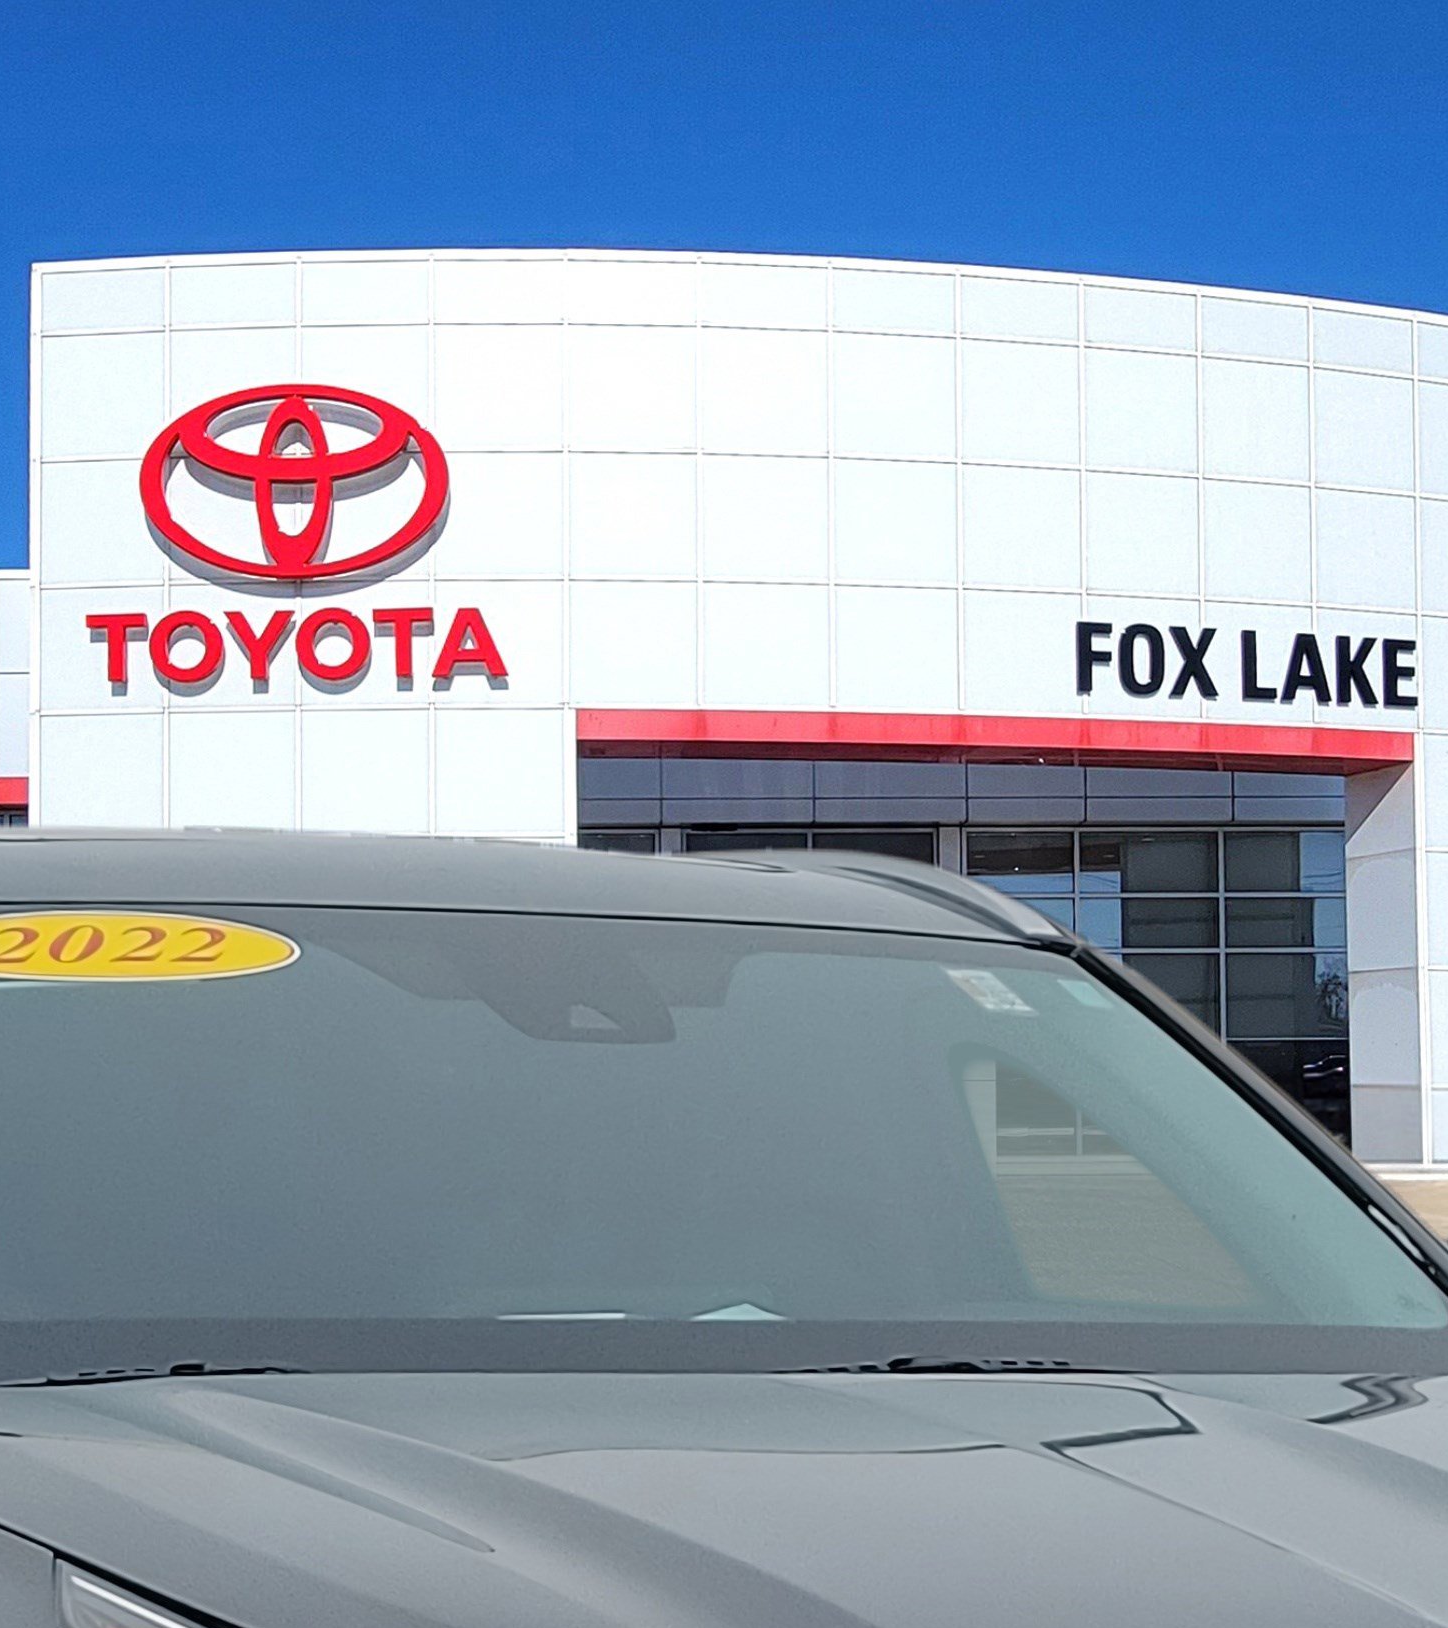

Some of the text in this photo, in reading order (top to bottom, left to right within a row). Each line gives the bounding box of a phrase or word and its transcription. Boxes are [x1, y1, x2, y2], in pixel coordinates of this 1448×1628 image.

[86, 607, 509, 686] TOYOTA
[1076, 621, 1419, 707] FOX LAKE
